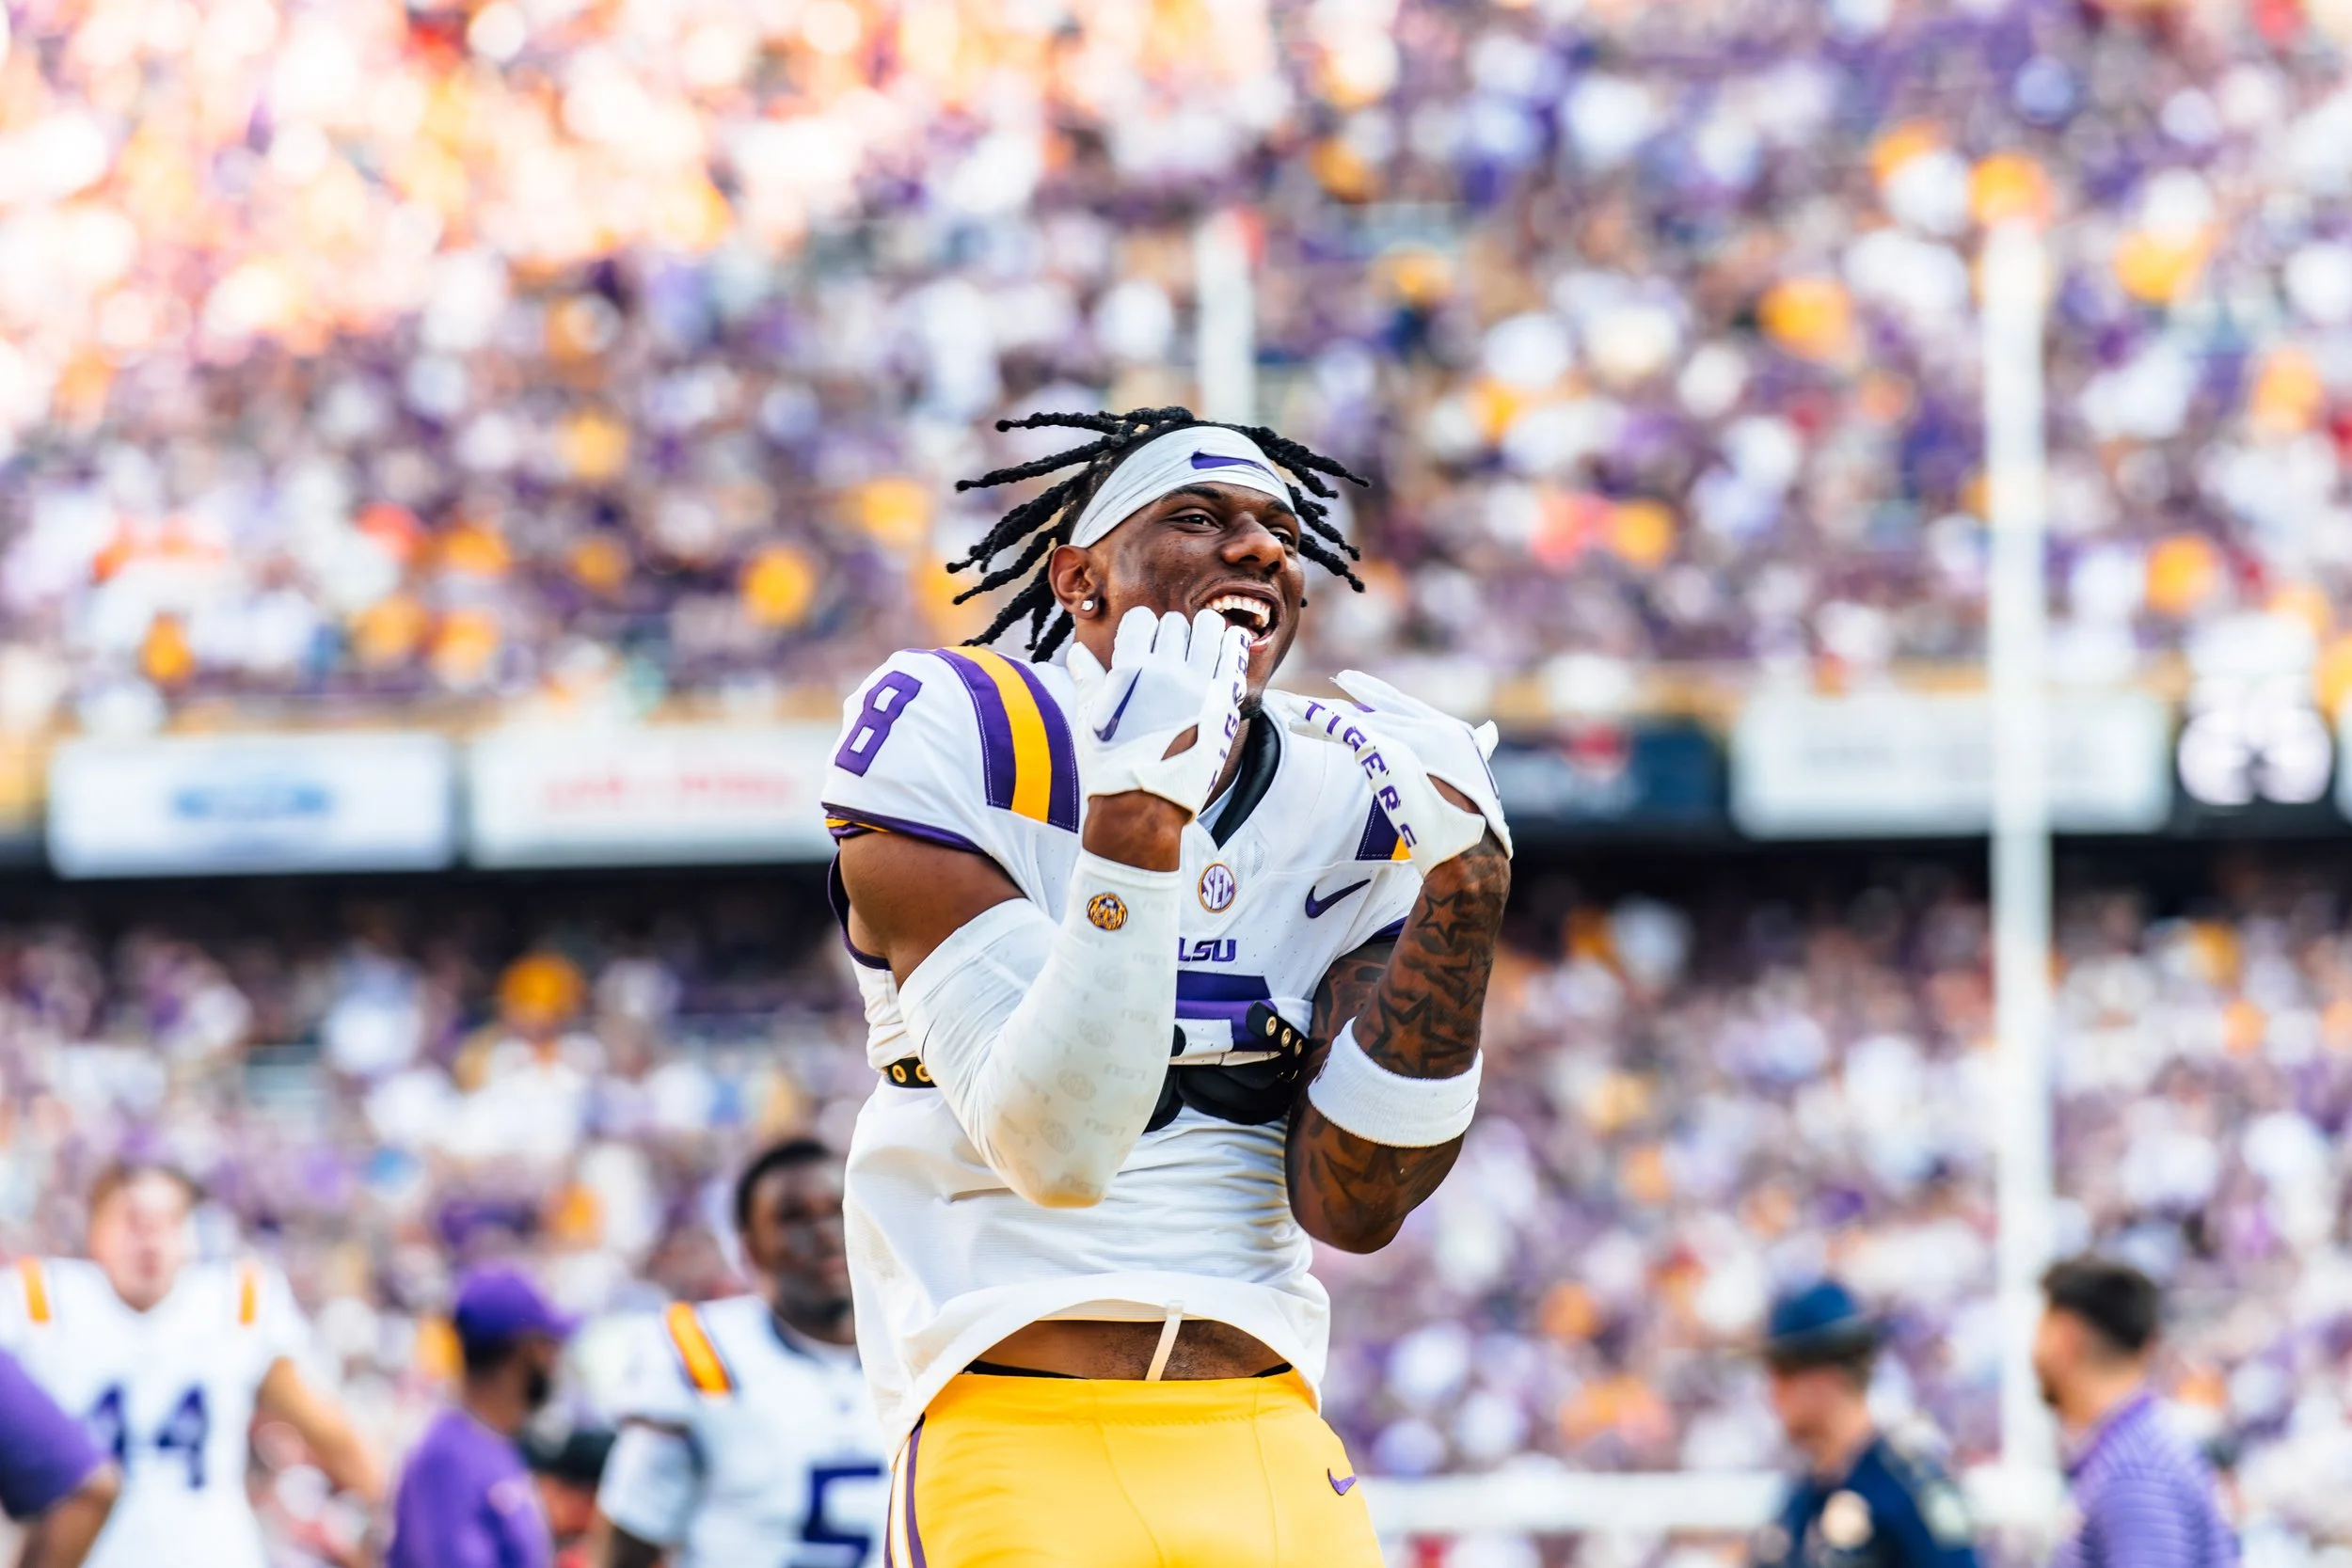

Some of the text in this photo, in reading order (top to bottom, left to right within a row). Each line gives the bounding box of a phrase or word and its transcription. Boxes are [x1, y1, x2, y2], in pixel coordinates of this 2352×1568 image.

[834, 670, 923, 777] 8
[1305, 701, 1418, 848] TIGERS
[1200, 863, 1235, 912] SEC
[1178, 937, 1237, 962] LSU
[88, 1379, 207, 1490] 44
[802, 1464, 882, 1568] 5
